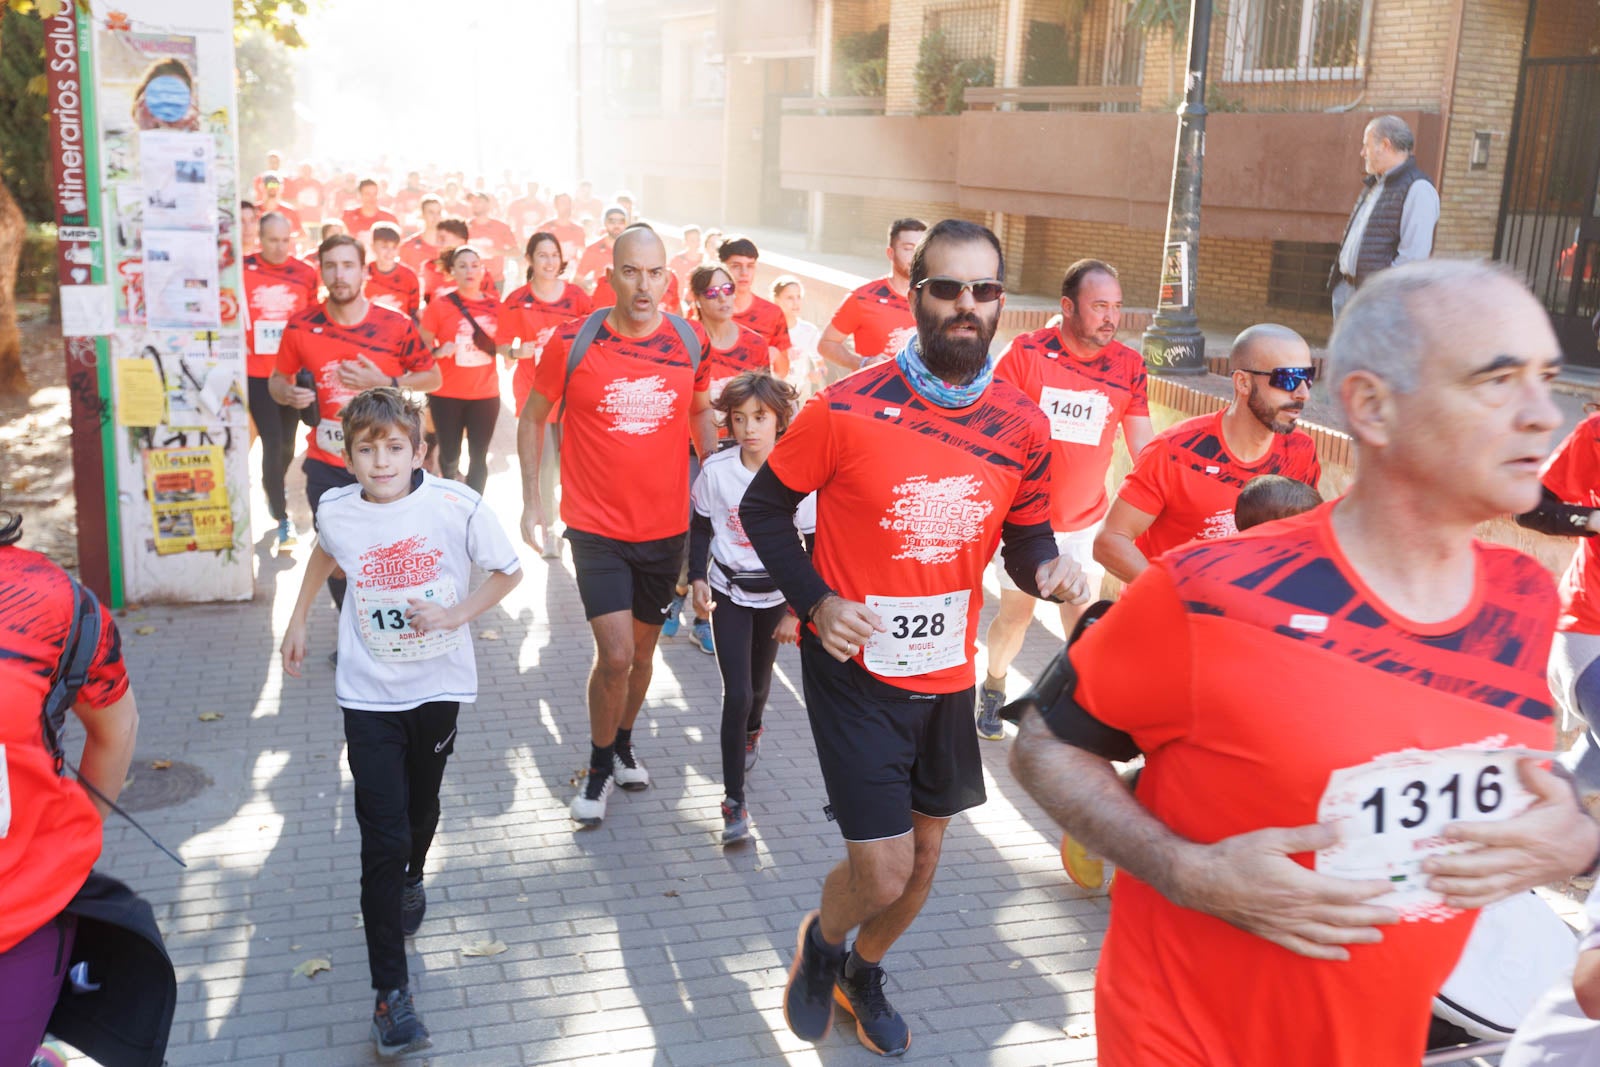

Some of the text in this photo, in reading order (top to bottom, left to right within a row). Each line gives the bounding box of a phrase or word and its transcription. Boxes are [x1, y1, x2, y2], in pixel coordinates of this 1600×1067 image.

[61, 230, 97, 239] MPS
[606, 391, 672, 406] carrera
[1051, 400, 1093, 420] 1401
[895, 498, 984, 523] carrera
[893, 518, 977, 537] cruzroja.es
[362, 555, 436, 576] carrera
[364, 569, 436, 588] cruzroja.es
[371, 609, 414, 630] 13
[892, 612, 945, 639] 328
[908, 641, 936, 651] MIGUEL
[1361, 764, 1504, 834] 1316
